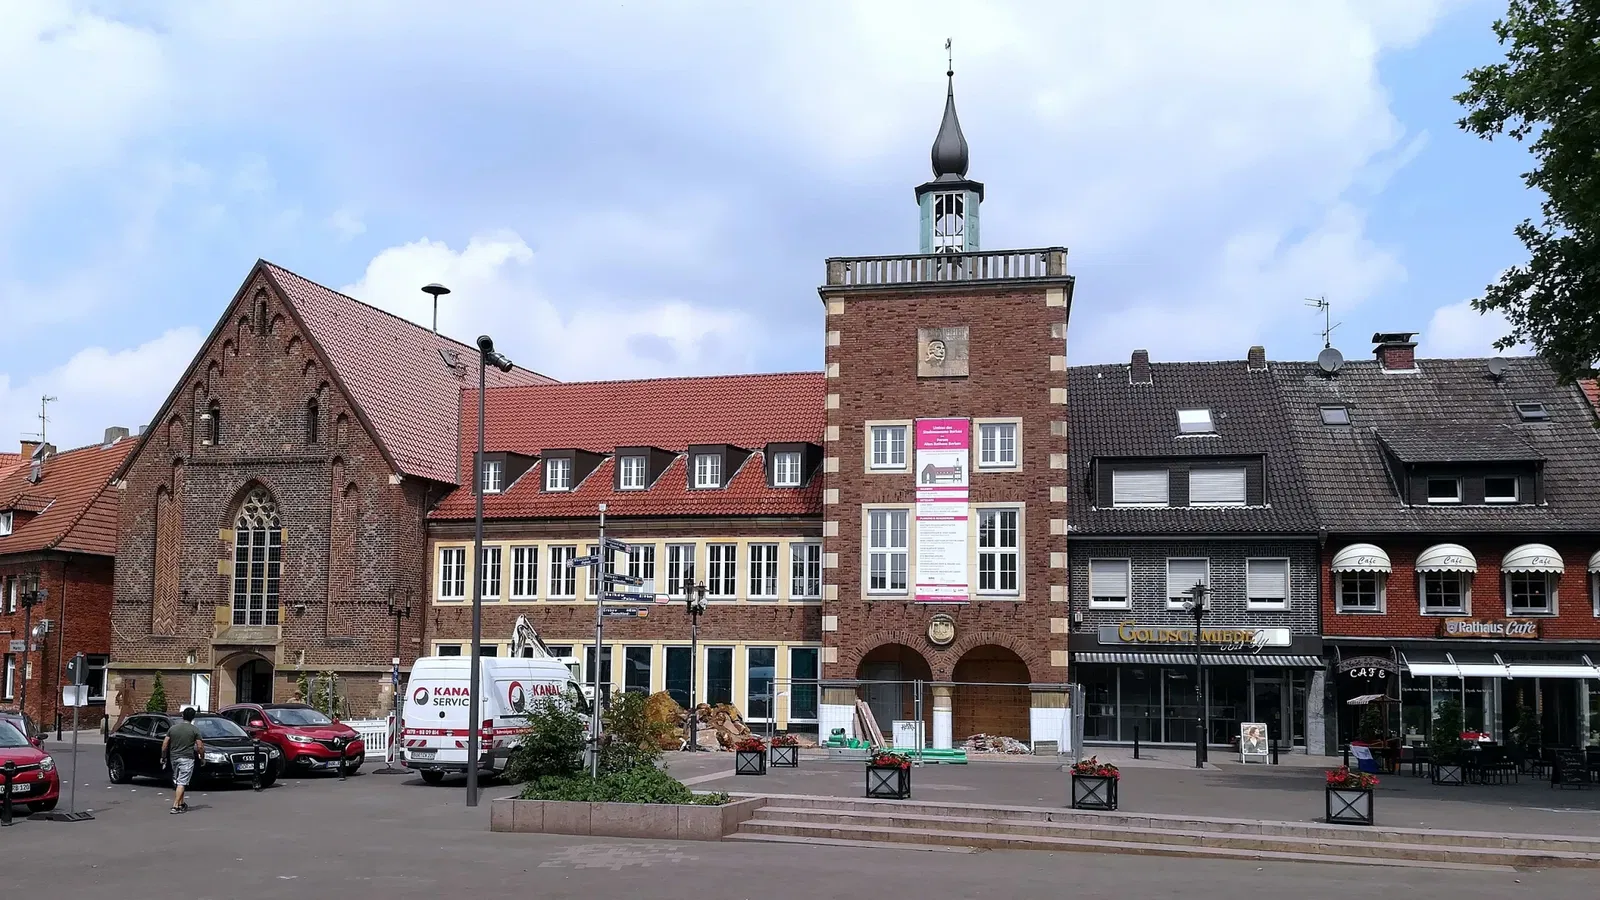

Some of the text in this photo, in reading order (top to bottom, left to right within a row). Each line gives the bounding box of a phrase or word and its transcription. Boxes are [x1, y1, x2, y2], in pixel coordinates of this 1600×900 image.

[1460, 621, 1504, 633] Rathaus
[1350, 668, 1386, 678] CAFE
[434, 687, 470, 696] KANA
[433, 698, 470, 706] SERVIC
